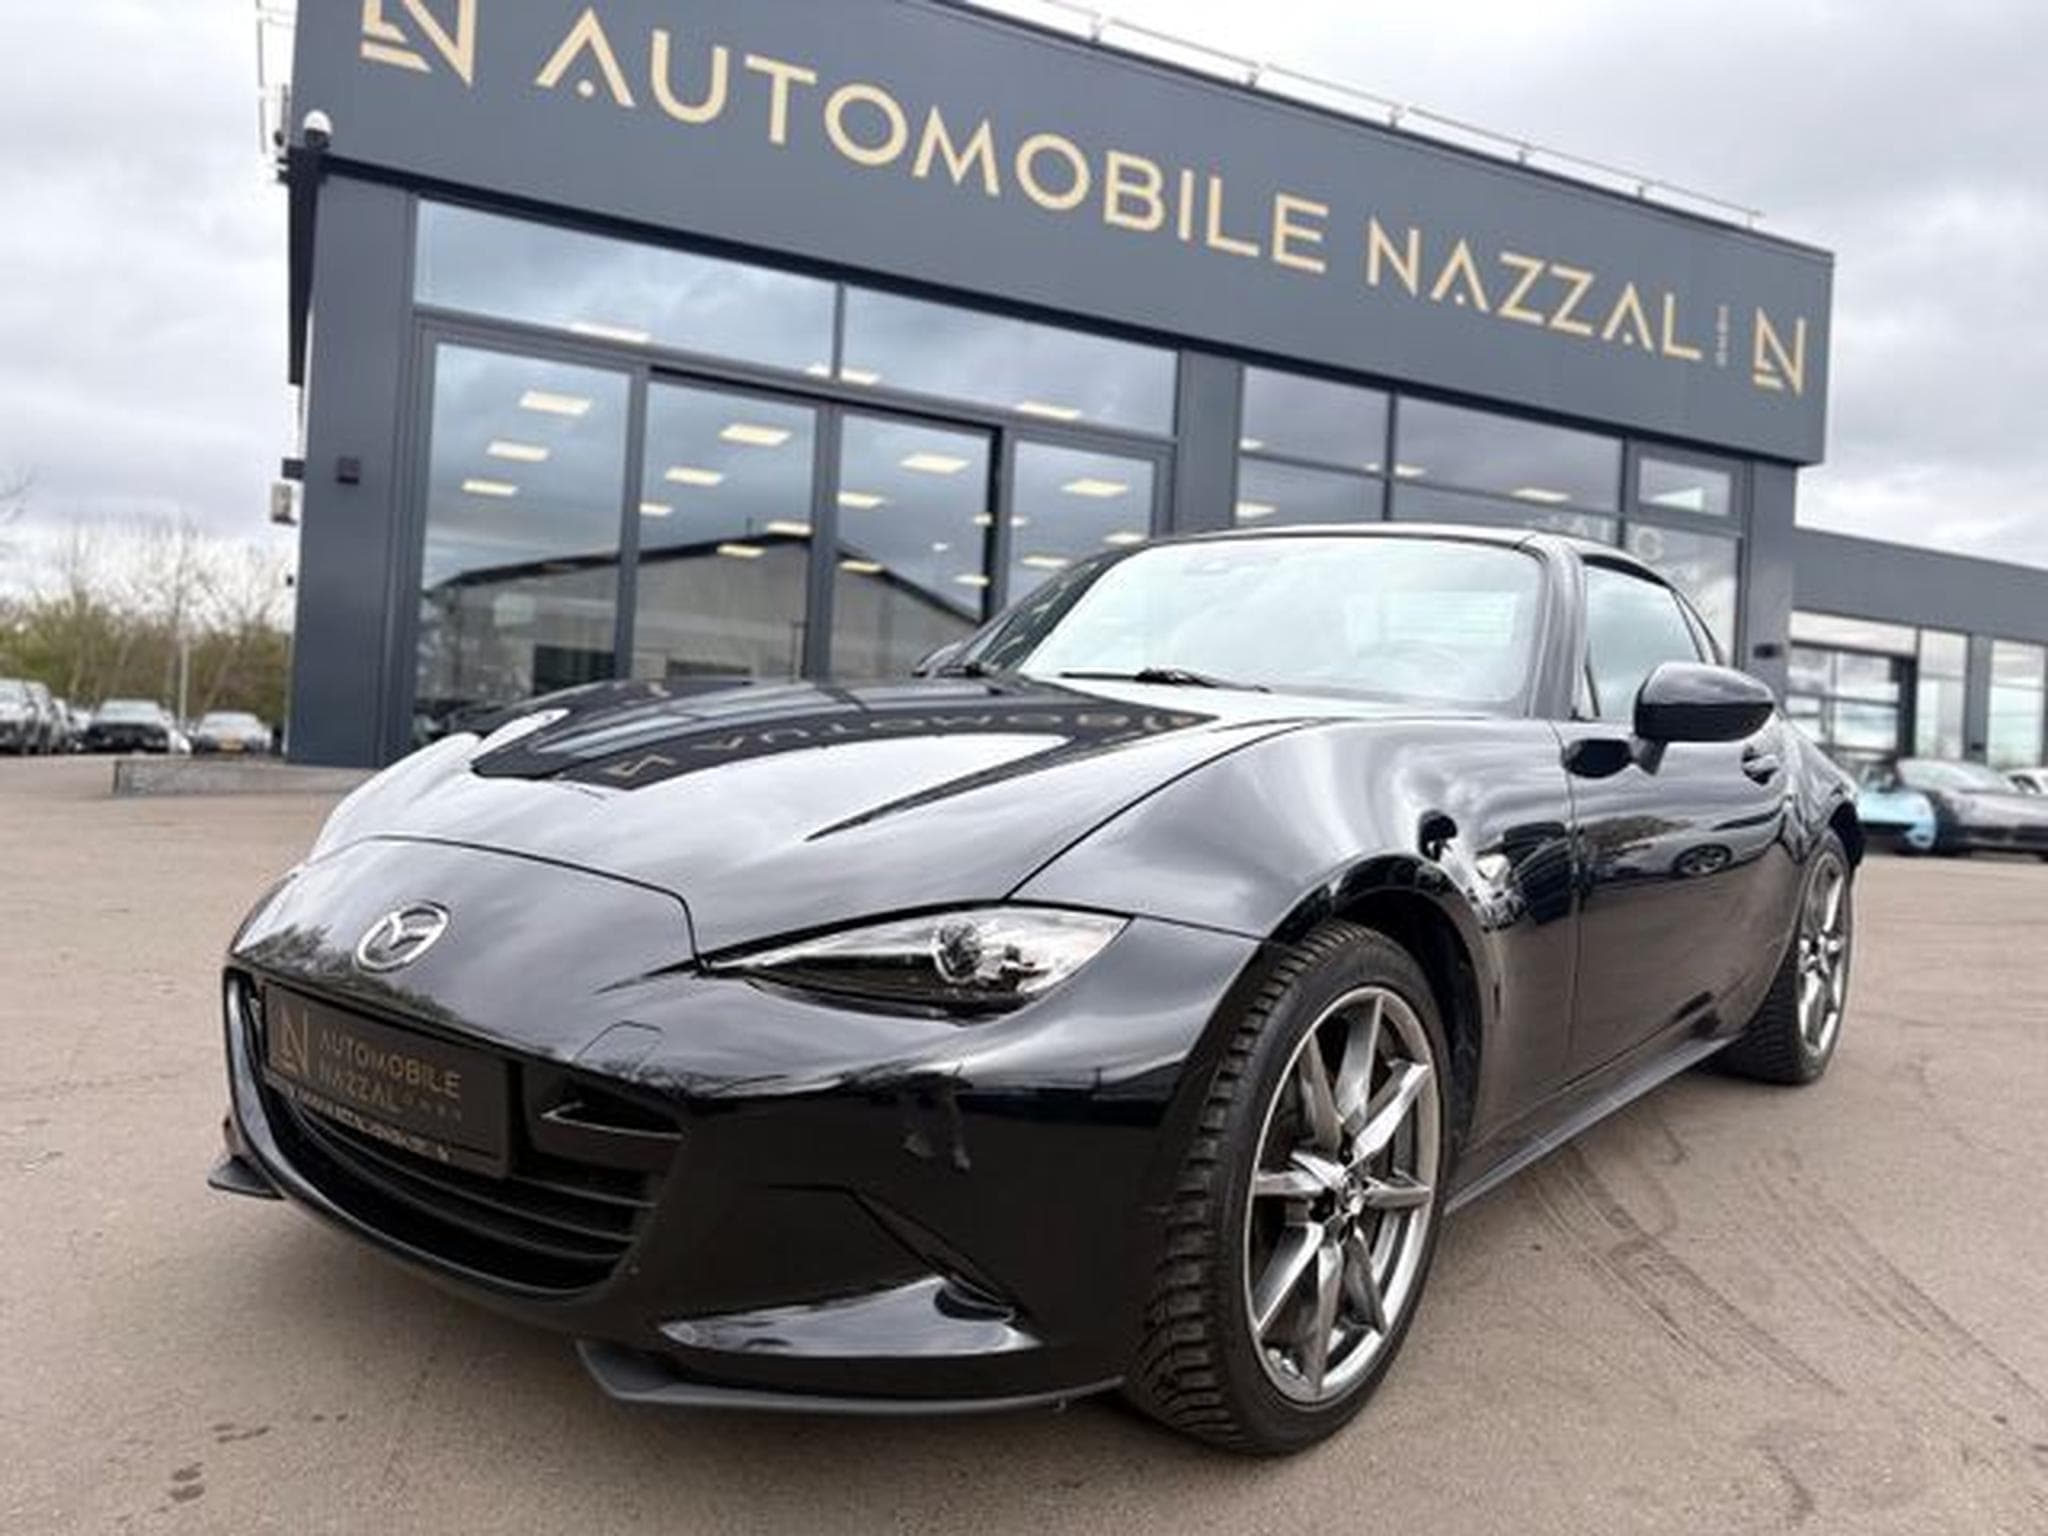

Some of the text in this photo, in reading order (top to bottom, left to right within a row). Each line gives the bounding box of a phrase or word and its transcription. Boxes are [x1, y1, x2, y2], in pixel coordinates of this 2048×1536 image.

[536, 8, 1330, 274] AUTOMOBILE
[1367, 216, 1703, 361] NAZZAL
[318, 1028, 462, 1100] AUTOMOBILE
